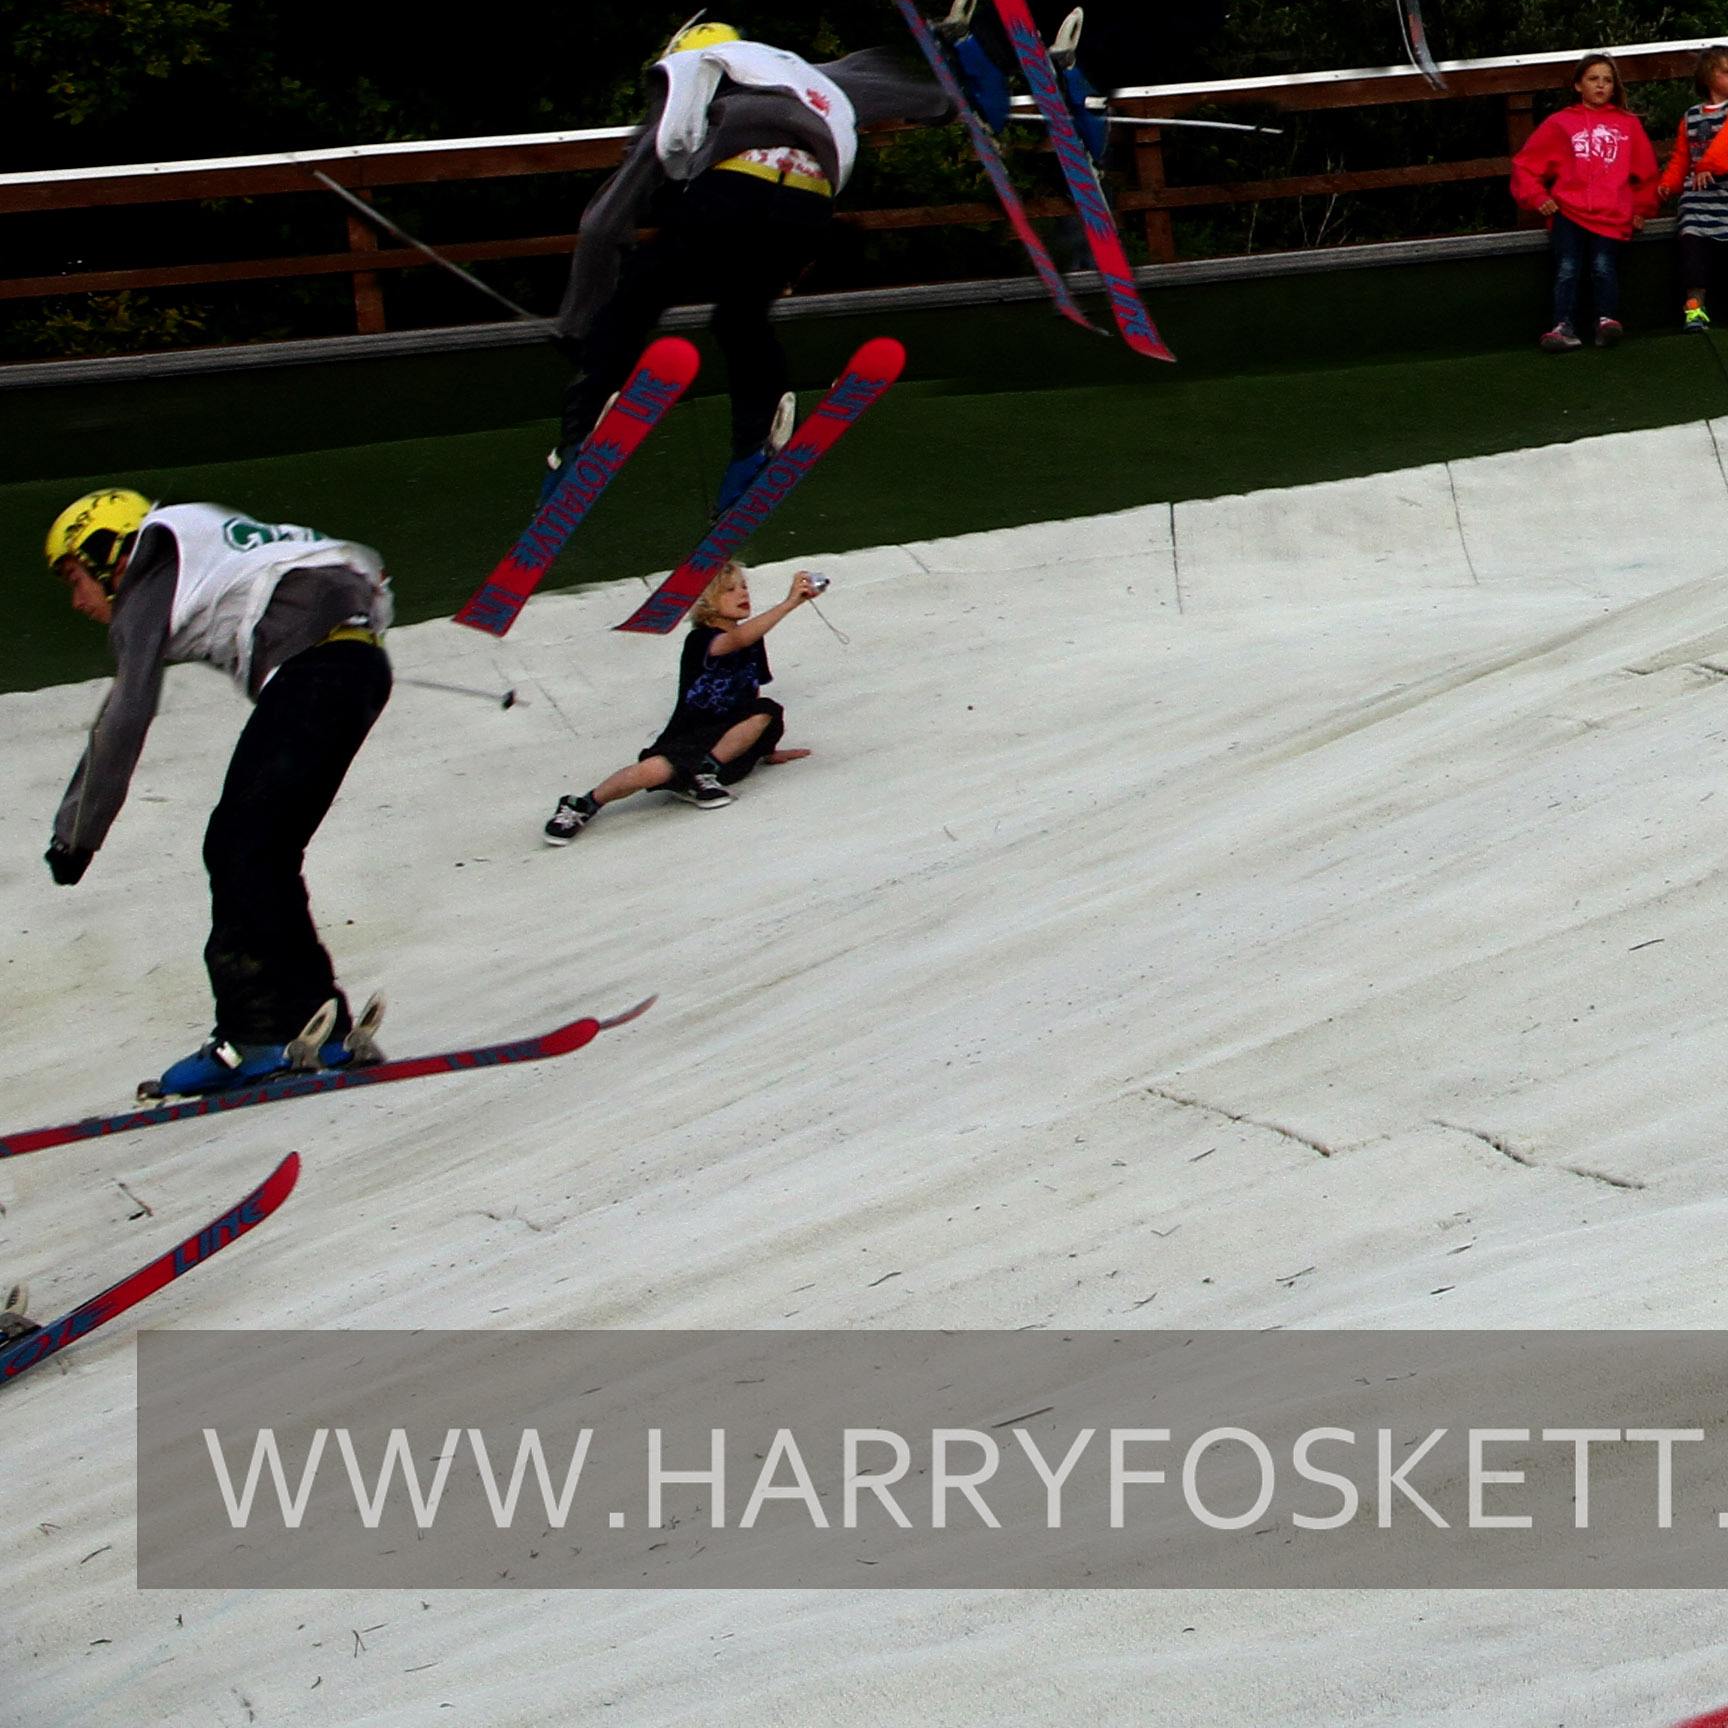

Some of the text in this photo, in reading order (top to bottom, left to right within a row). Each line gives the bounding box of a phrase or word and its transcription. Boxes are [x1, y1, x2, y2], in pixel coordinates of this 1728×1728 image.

[1103, 273, 1159, 346] LINE
[614, 368, 681, 425] LINE
[816, 372, 888, 422] LINE
[172, 1190, 266, 1278] LINE
